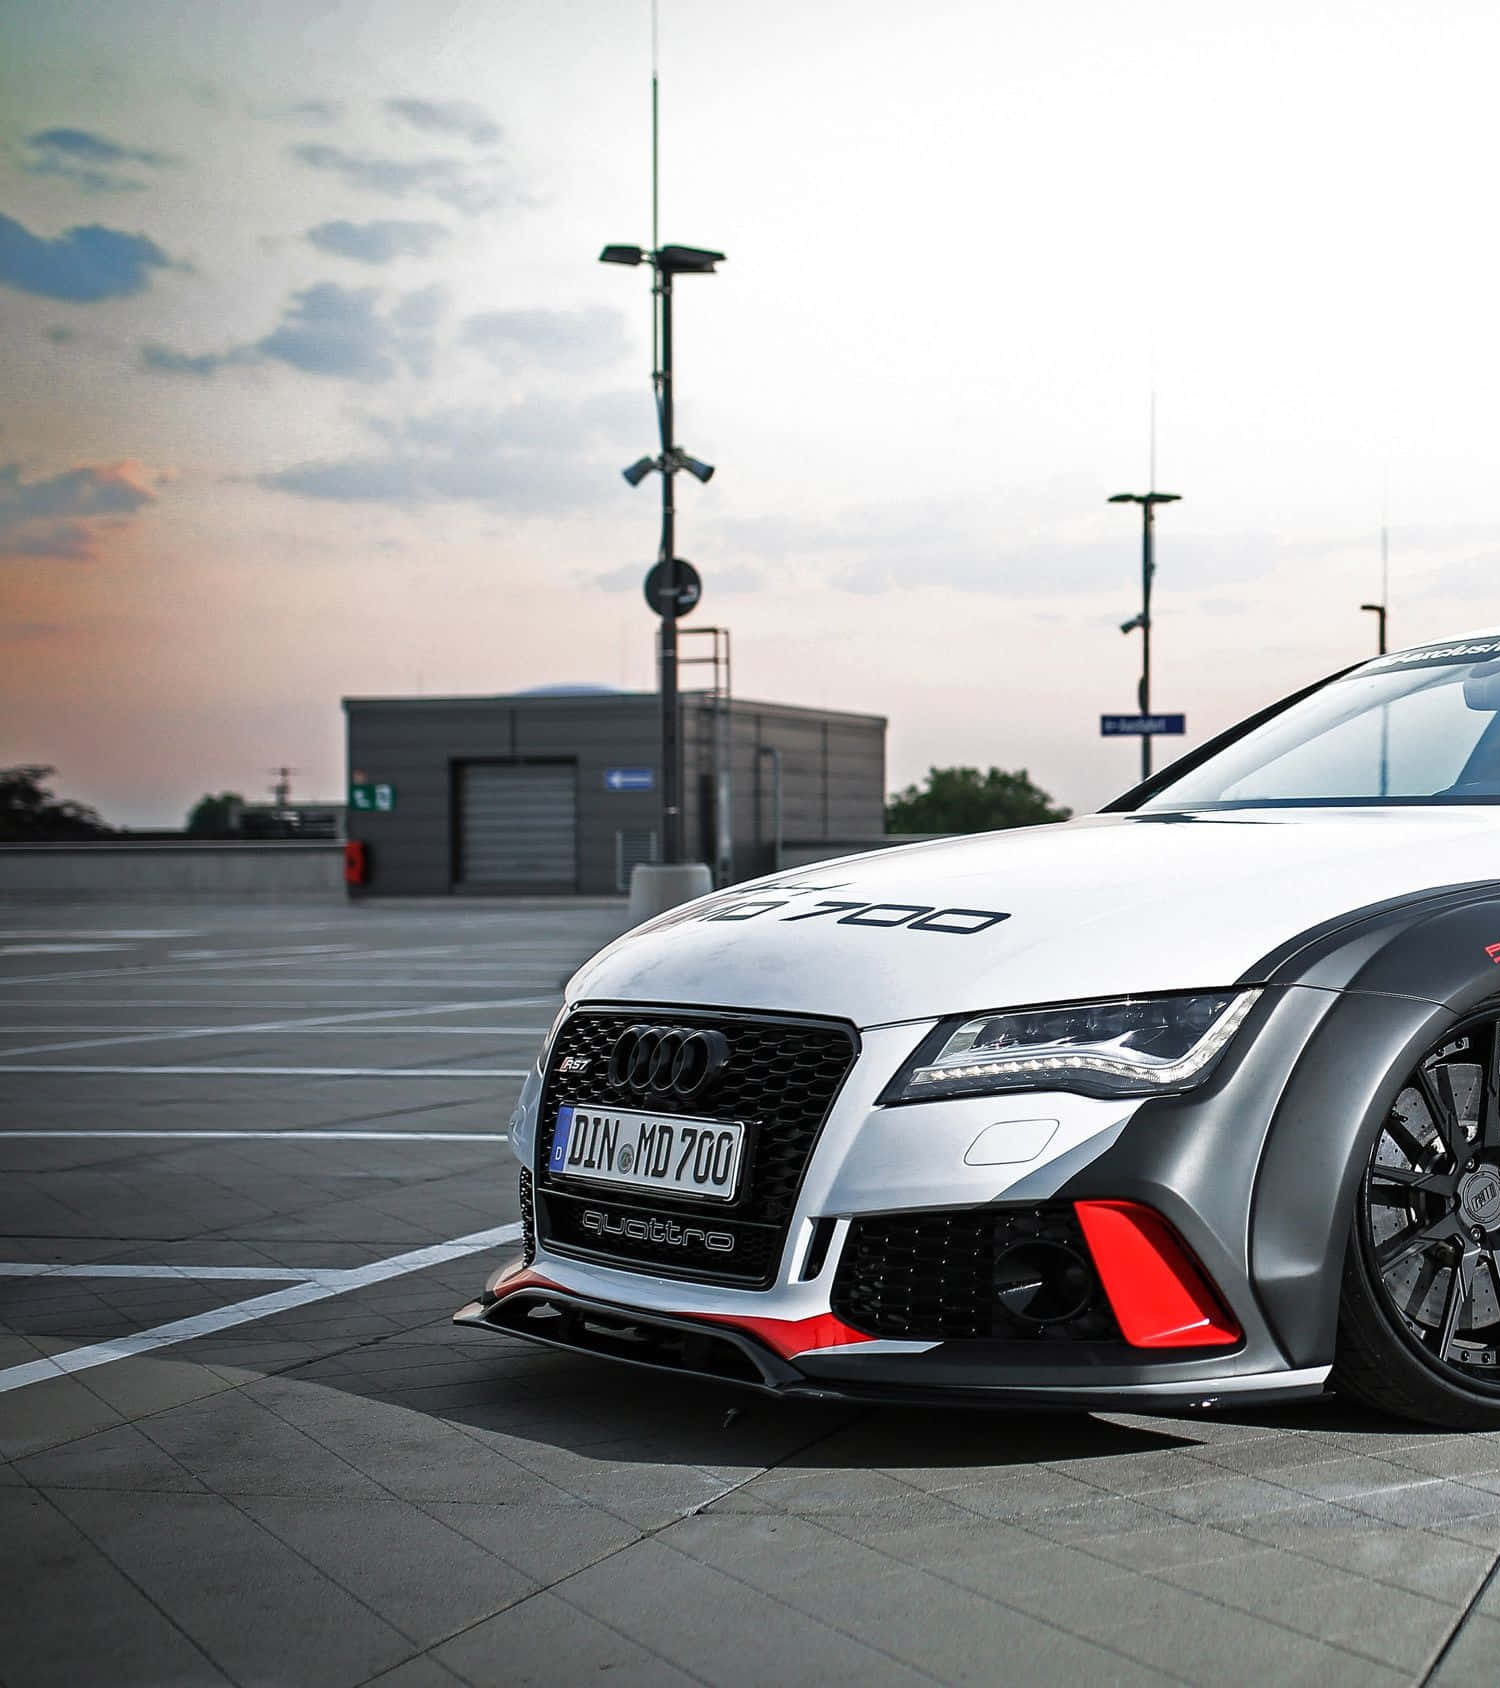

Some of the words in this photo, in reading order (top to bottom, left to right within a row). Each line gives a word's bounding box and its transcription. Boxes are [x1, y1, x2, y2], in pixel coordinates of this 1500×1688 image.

[779, 901, 1012, 934] 700
[563, 1057, 592, 1071] RS7
[554, 1146, 563, 1161] D
[567, 1114, 620, 1171] DIN
[633, 1122, 674, 1178] MD
[674, 1127, 734, 1186] 700
[582, 1209, 735, 1252] quattro
